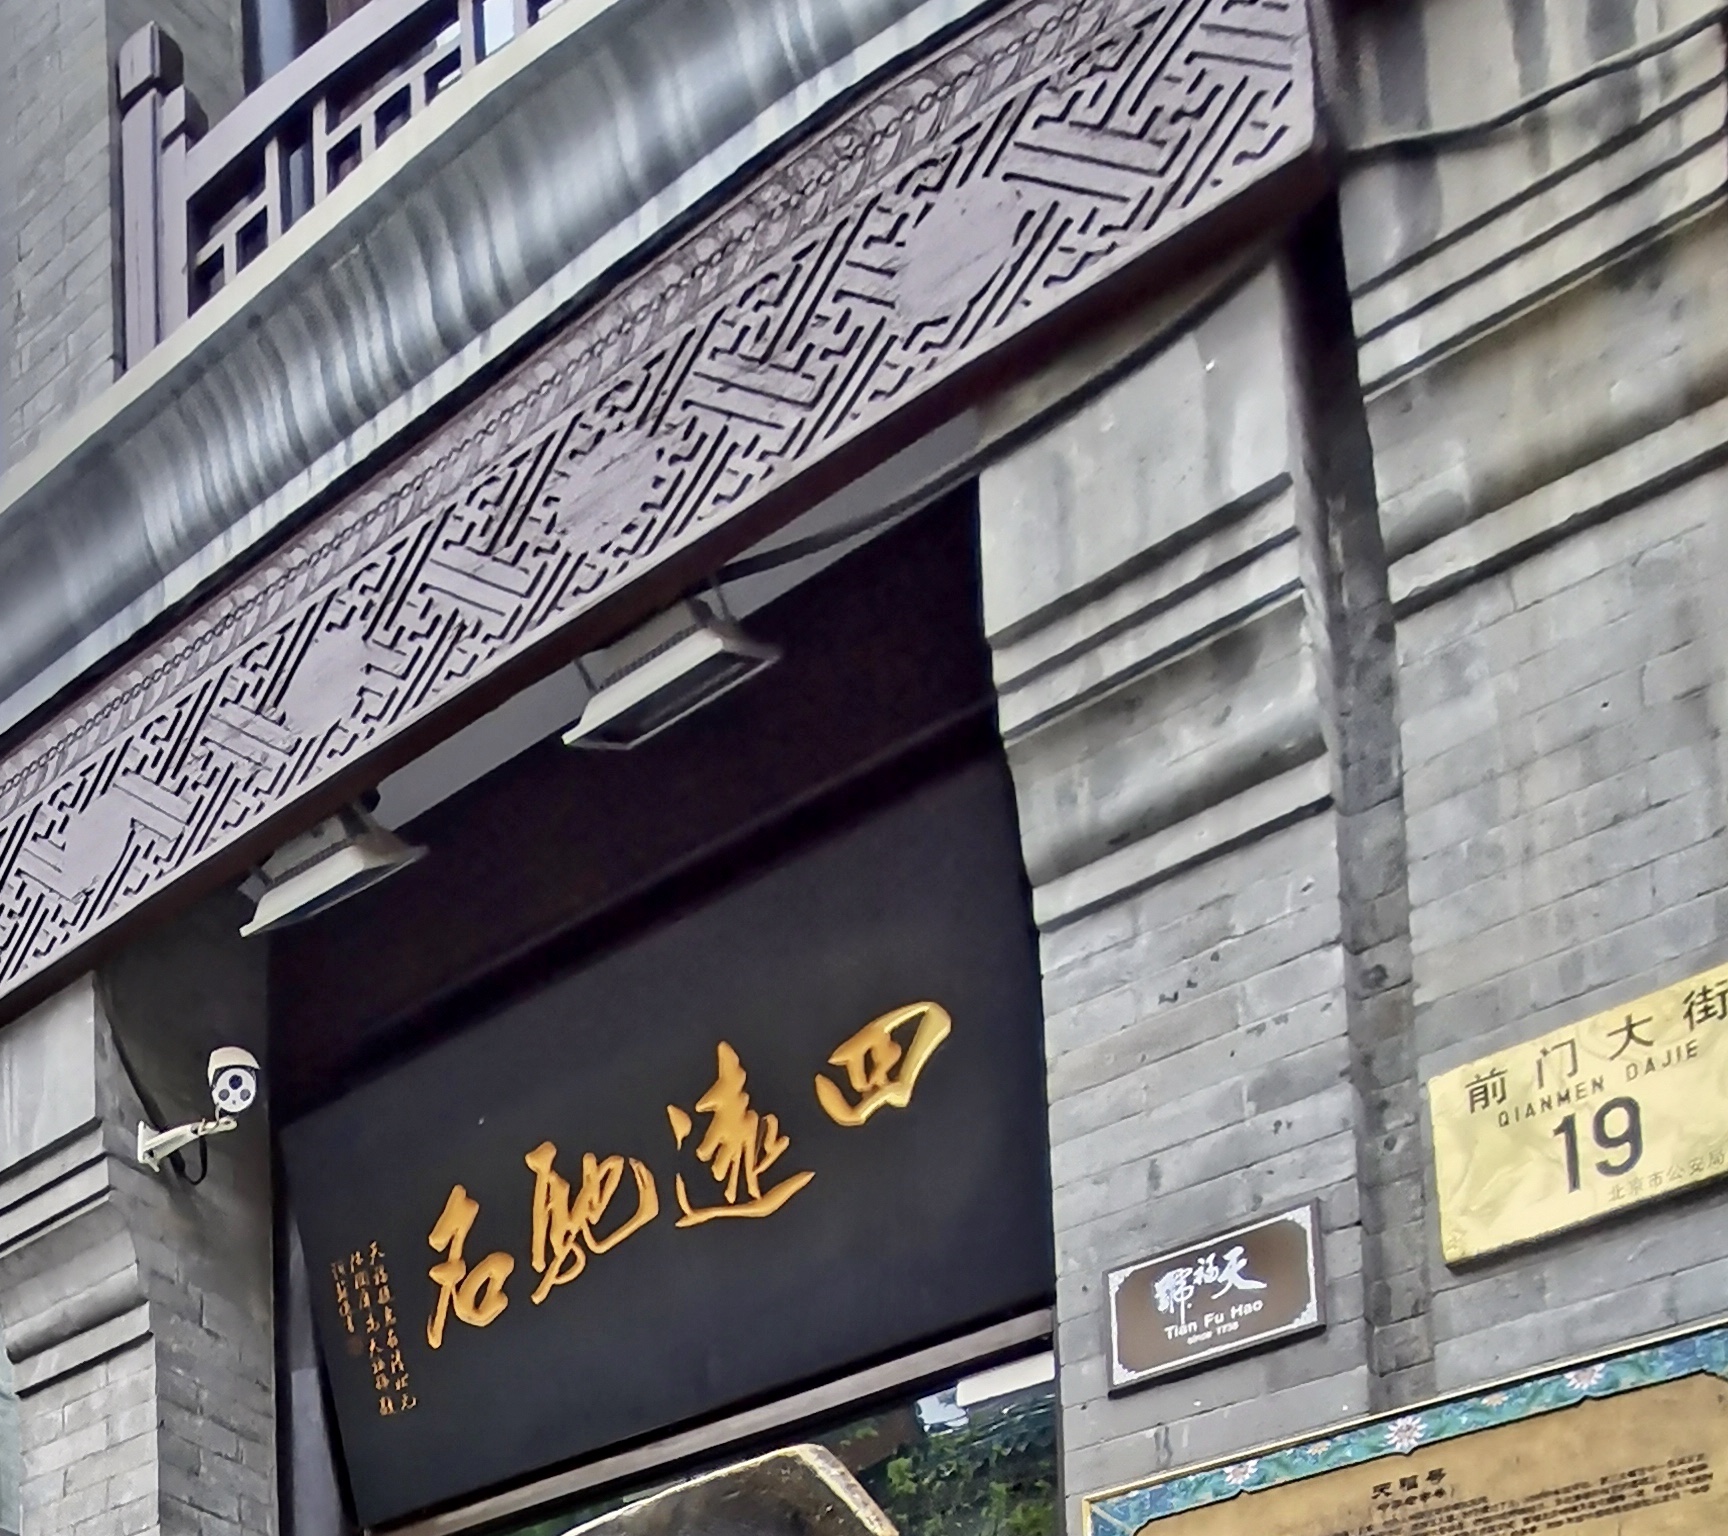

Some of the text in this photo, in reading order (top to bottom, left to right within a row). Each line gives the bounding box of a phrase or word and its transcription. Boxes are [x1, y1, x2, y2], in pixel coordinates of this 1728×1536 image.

[1465, 979, 1728, 1114] 前门大街
[1498, 1039, 1699, 1128] QIANMEN DAJIE
[1552, 1095, 1643, 1194] 19
[1608, 1150, 1726, 1202] 北京市公安局
[1164, 1300, 1264, 1340] Tian Fu Hao
